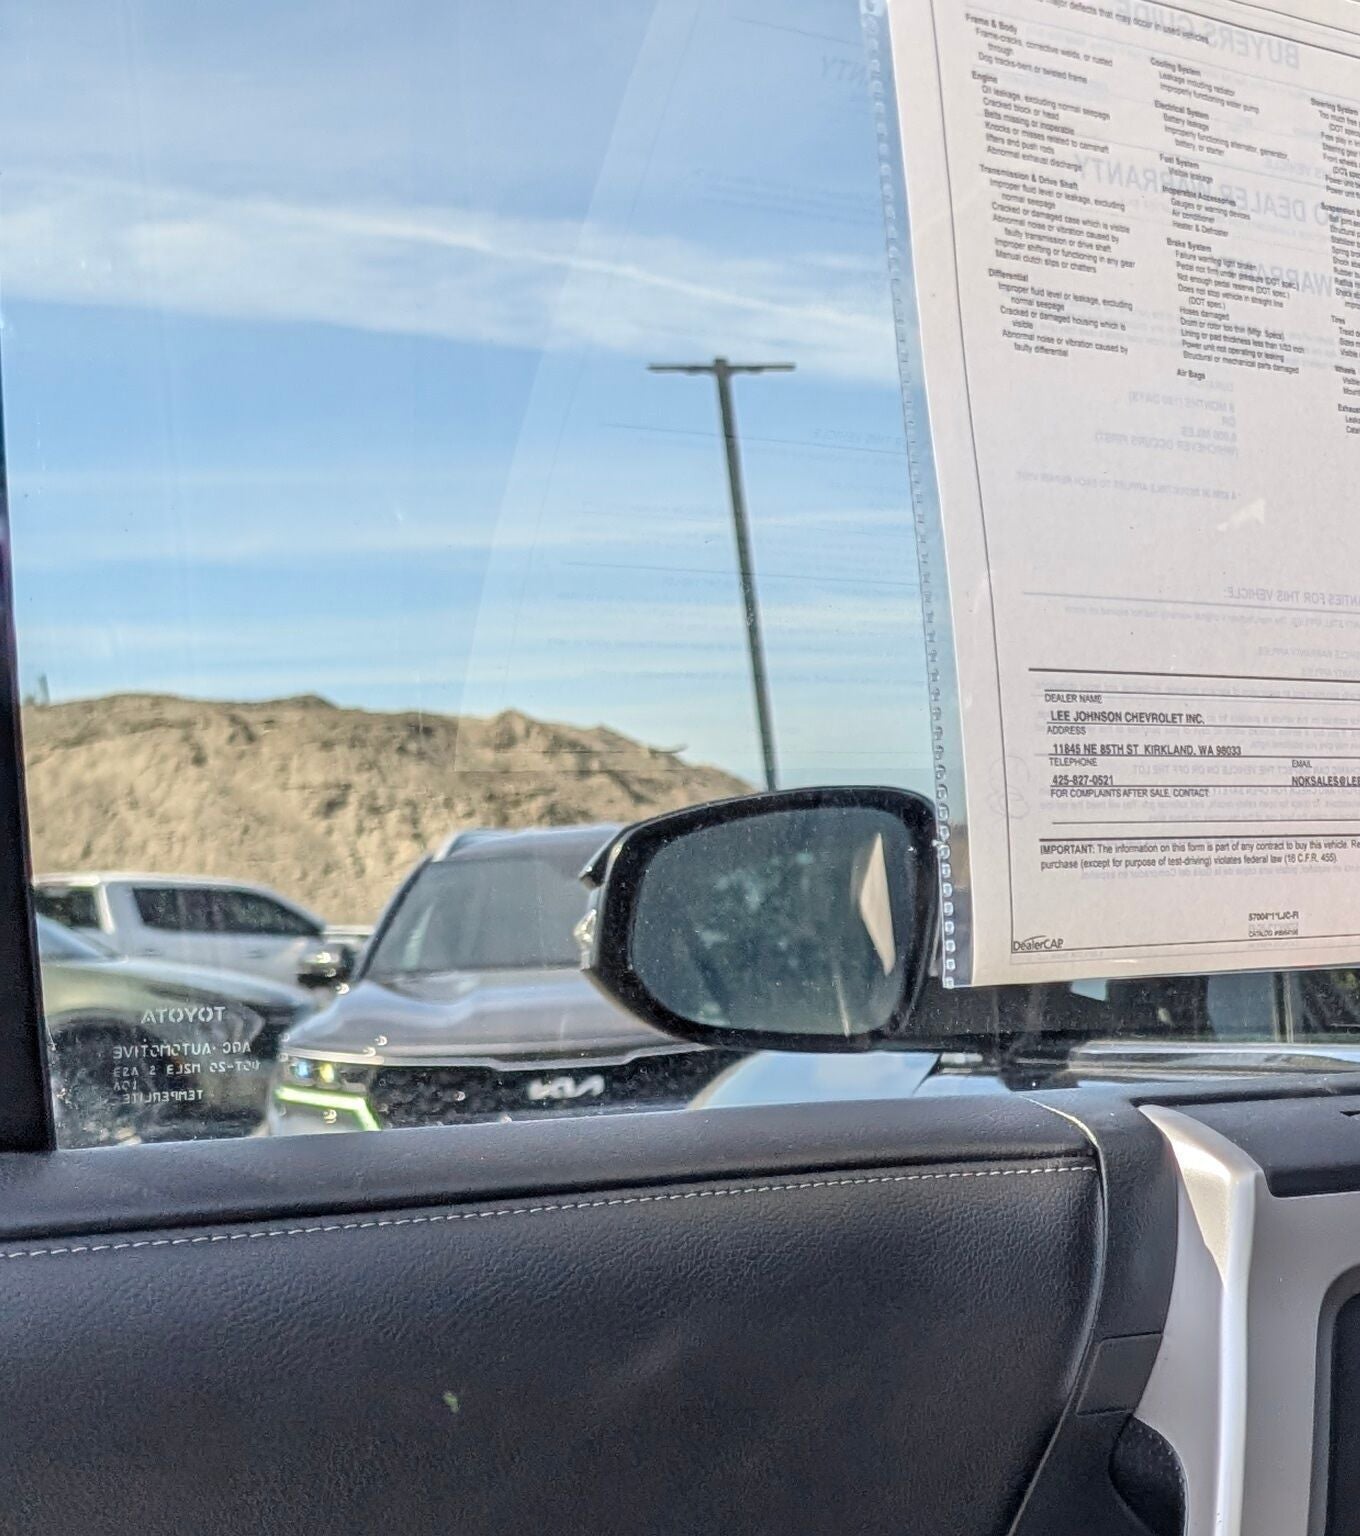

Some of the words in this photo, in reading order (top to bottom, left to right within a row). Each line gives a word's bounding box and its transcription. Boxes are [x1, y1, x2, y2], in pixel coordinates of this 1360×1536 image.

[988, 268, 1028, 281] Differential
[1044, 693, 1077, 703] DEALER
[1079, 694, 1102, 703] NAME
[1050, 710, 1070, 721] LEE
[1073, 711, 1122, 722] JOHNSON
[1124, 712, 1183, 723] CHEVROLET
[1185, 713, 1204, 724] INC.
[1046, 726, 1086, 735] ADDRESS
[1053, 743, 1081, 754] 11845
[1083, 744, 1097, 754] NE
[1100, 744, 1124, 754] 85TH
[1198, 745, 1213, 756] WA
[1050, 757, 1097, 766] TELEPHONE
[1291, 760, 1312, 768] EMAIL
[1052, 774, 1113, 785] 425-827-0521
[1050, 789, 1068, 797] FOR
[1069, 789, 1121, 797] COMPLAINTS
[1122, 789, 1148, 797] AFTER
[1040, 844, 1095, 853] IMPORTANT:
[1097, 844, 1112, 852] The
[1114, 843, 1158, 852] information
[1171, 843, 1185, 851] this
[1187, 843, 1205, 851] form
[1207, 843, 1212, 851] is
[1215, 842, 1230, 853] part
[1231, 842, 1238, 850] of
[1241, 844, 1254, 852] any
[1256, 842, 1284, 850] contract
[1286, 841, 1293, 849] to
[1295, 841, 1307, 851] buy
[1309, 841, 1321, 849] this
[1040, 859, 1078, 871] purchase
[1080, 858, 1110, 870] (except
[1112, 858, 1122, 866] for
[1124, 859, 1156, 869] purpose
[1158, 857, 1166, 865] of
[1167, 856, 1212, 868] test-driving)
[1214, 856, 1241, 864] violates
[1243, 855, 1268, 864] federal
[1270, 855, 1282, 863] law
[1011, 939, 1063, 949] DealerCAP
